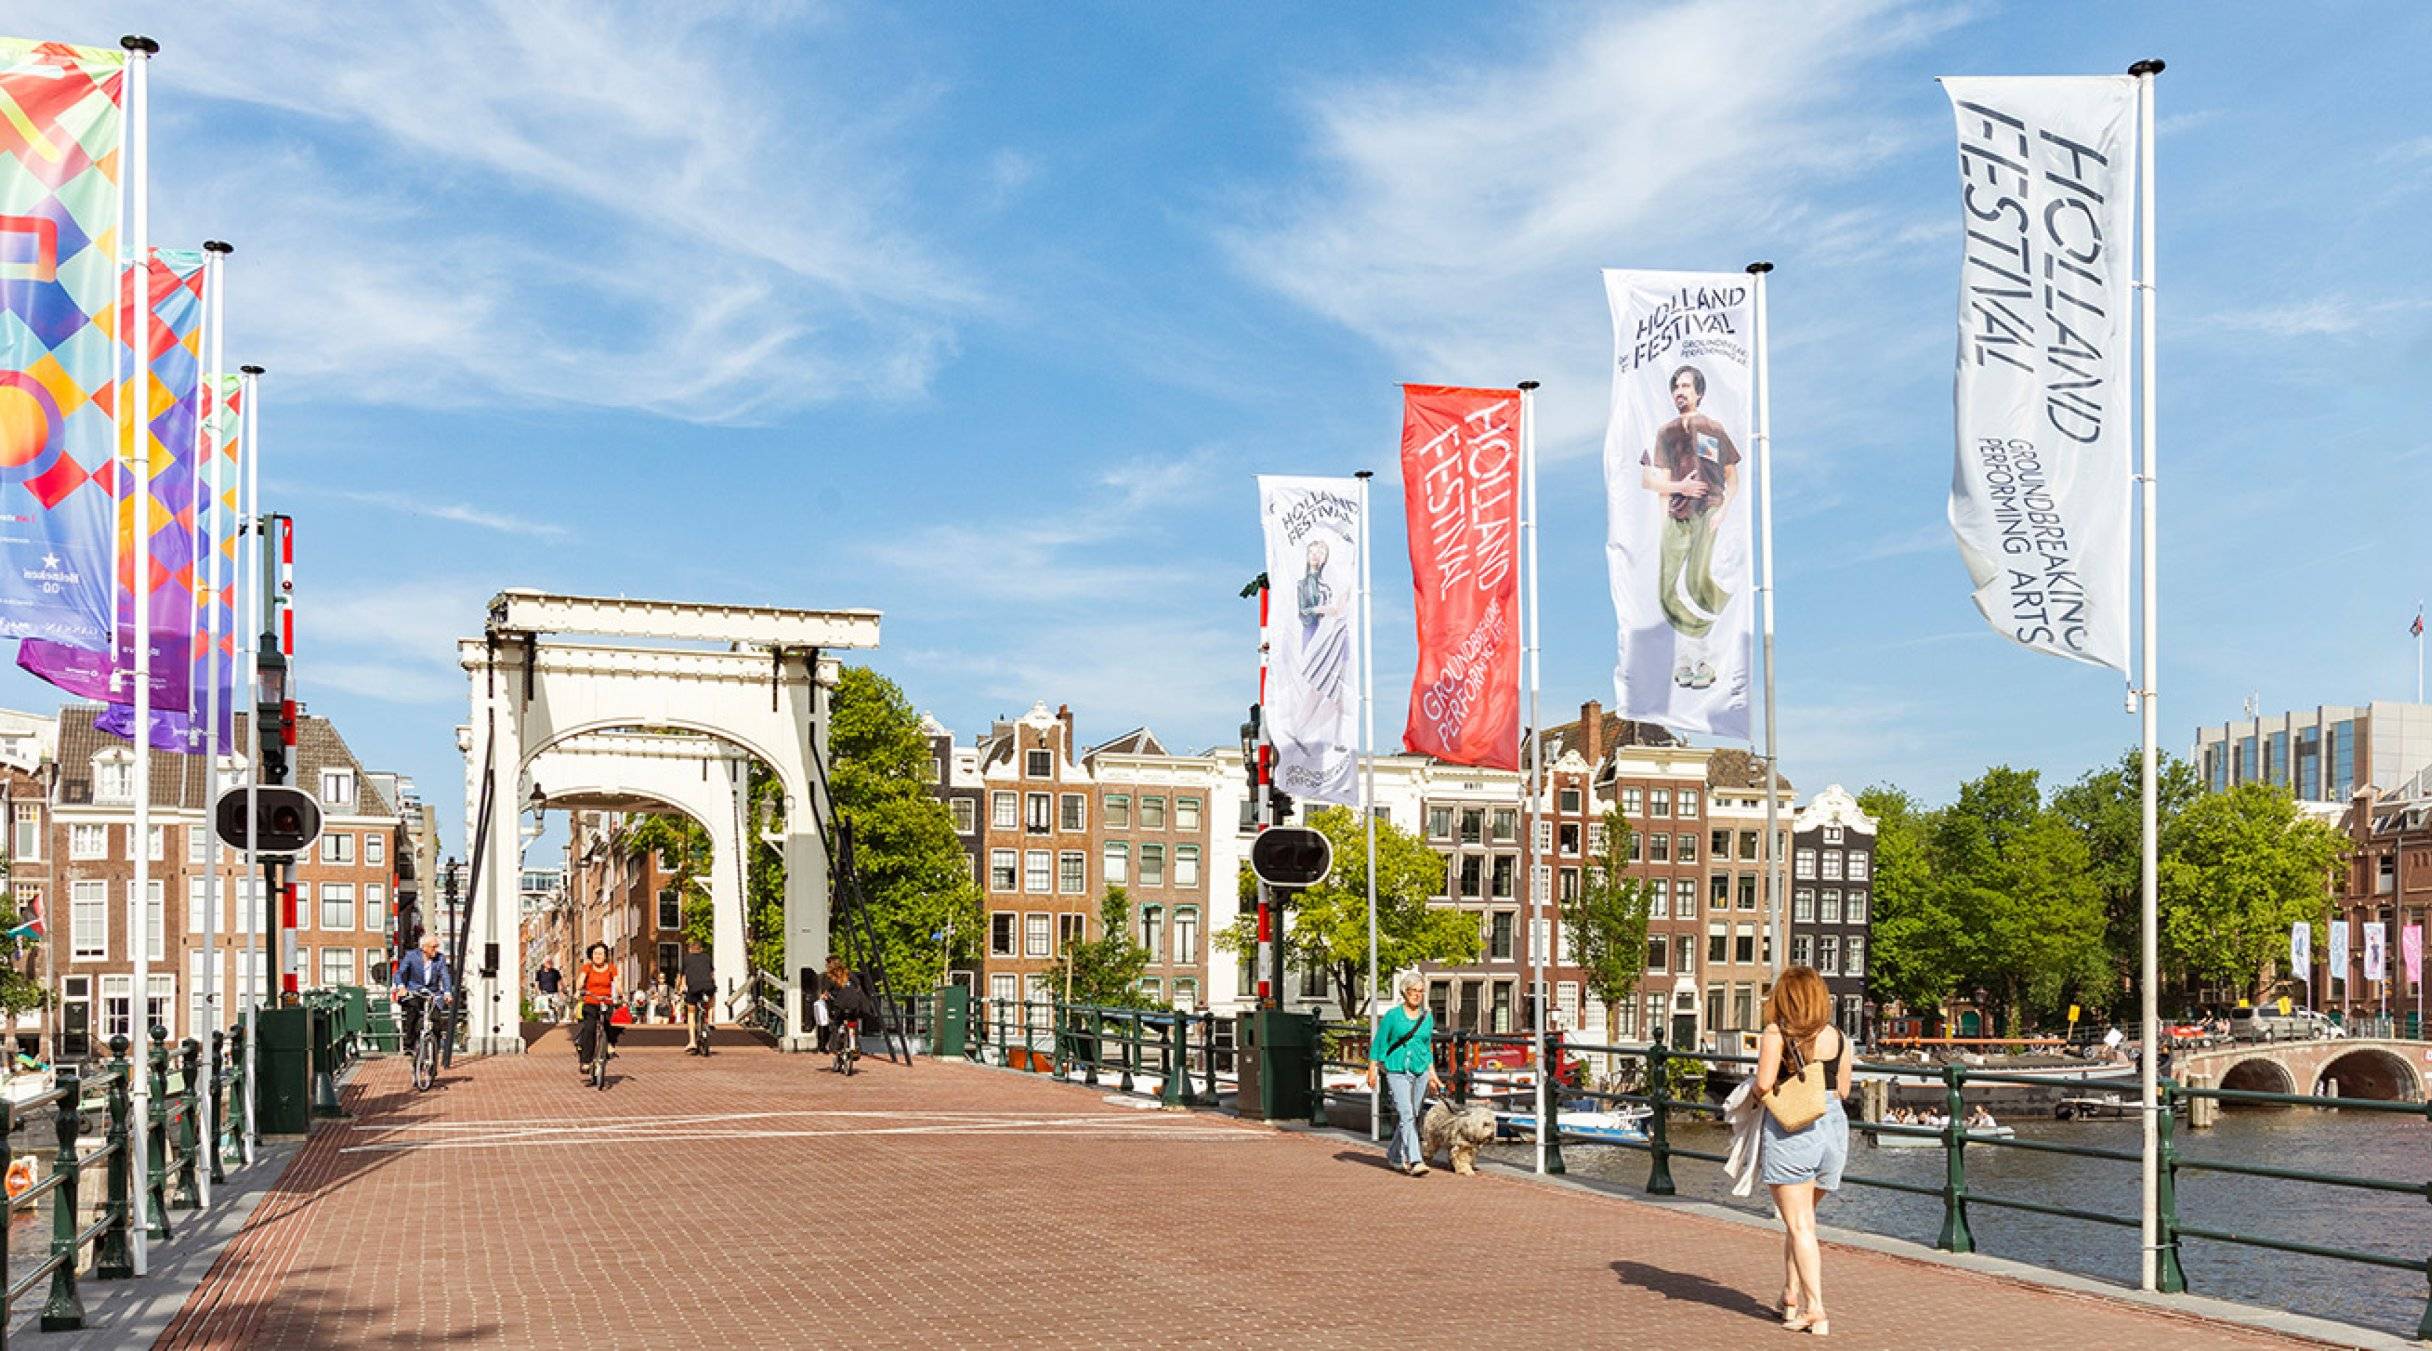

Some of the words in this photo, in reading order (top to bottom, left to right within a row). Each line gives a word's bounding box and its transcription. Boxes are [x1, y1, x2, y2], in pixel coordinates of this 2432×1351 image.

[1636, 286, 1746, 341] HOLLAND
[1956, 99, 2035, 374] FESTIVAL
[2040, 129, 2109, 443] HOLLAND
[1633, 312, 1737, 369] FESTIVAL
[1282, 491, 1360, 531] HOLLAND
[1419, 424, 1471, 601] FESTIVAL
[1464, 399, 1512, 591] HOLLAND
[1977, 437, 2032, 555] PERFORMING
[2007, 568, 2055, 644] ARTS
